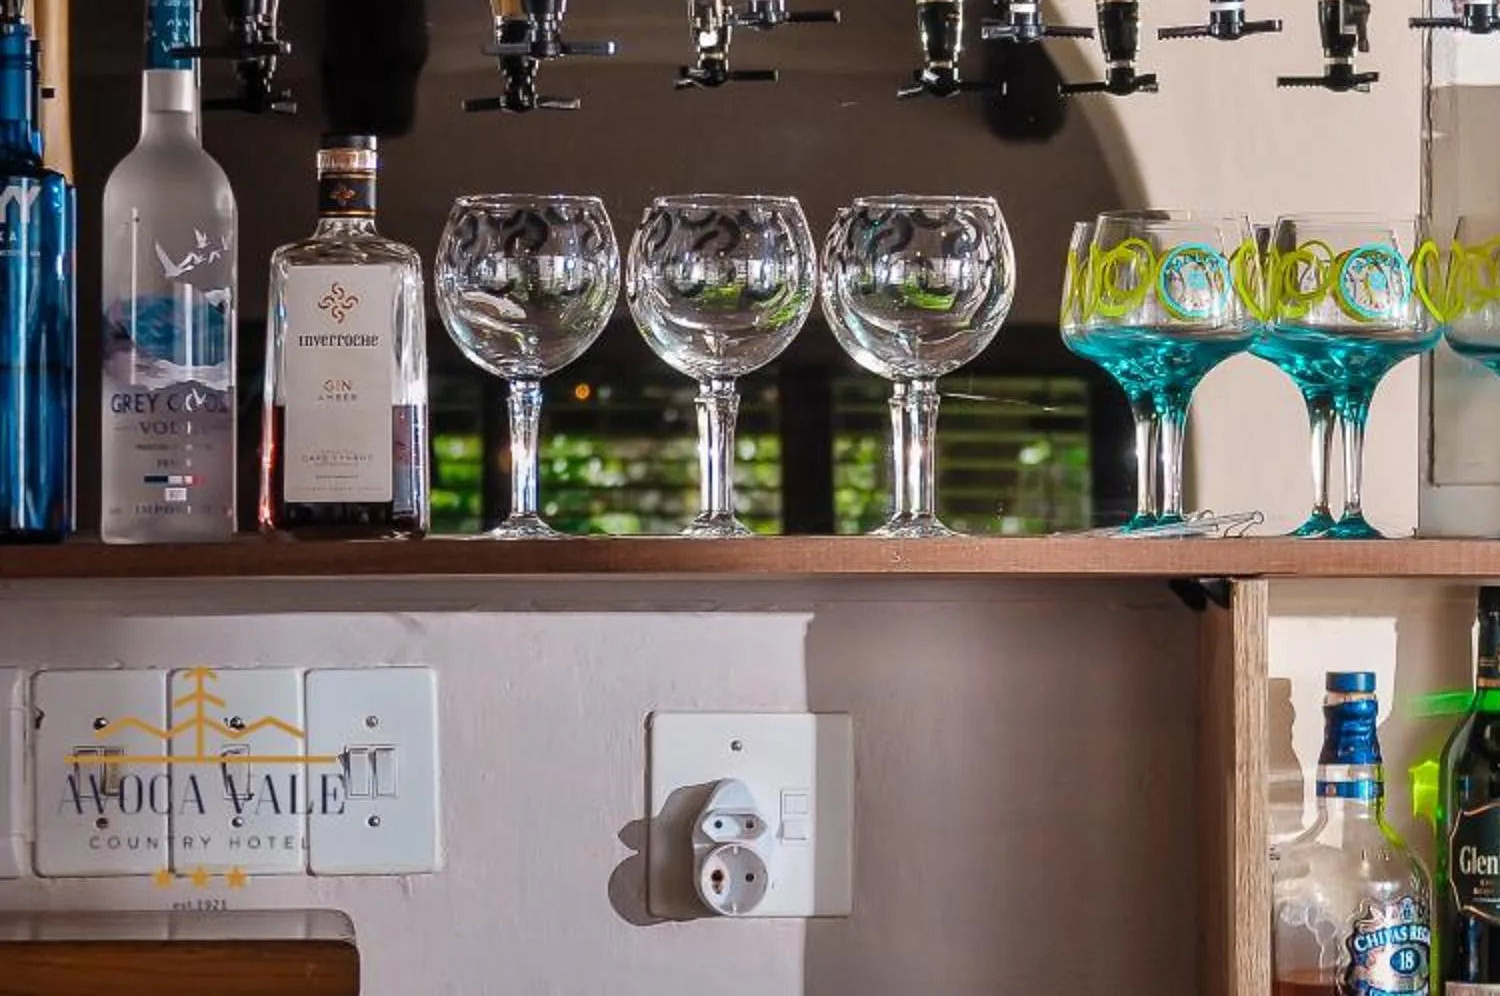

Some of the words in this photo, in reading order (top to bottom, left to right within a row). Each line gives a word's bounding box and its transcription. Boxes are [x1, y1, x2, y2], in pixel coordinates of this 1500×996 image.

[323, 379, 353, 392] GIN
[111, 392, 160, 414] GREY
[1354, 926, 1407, 952] CHIVAS
[1399, 952, 1415, 971] 18
